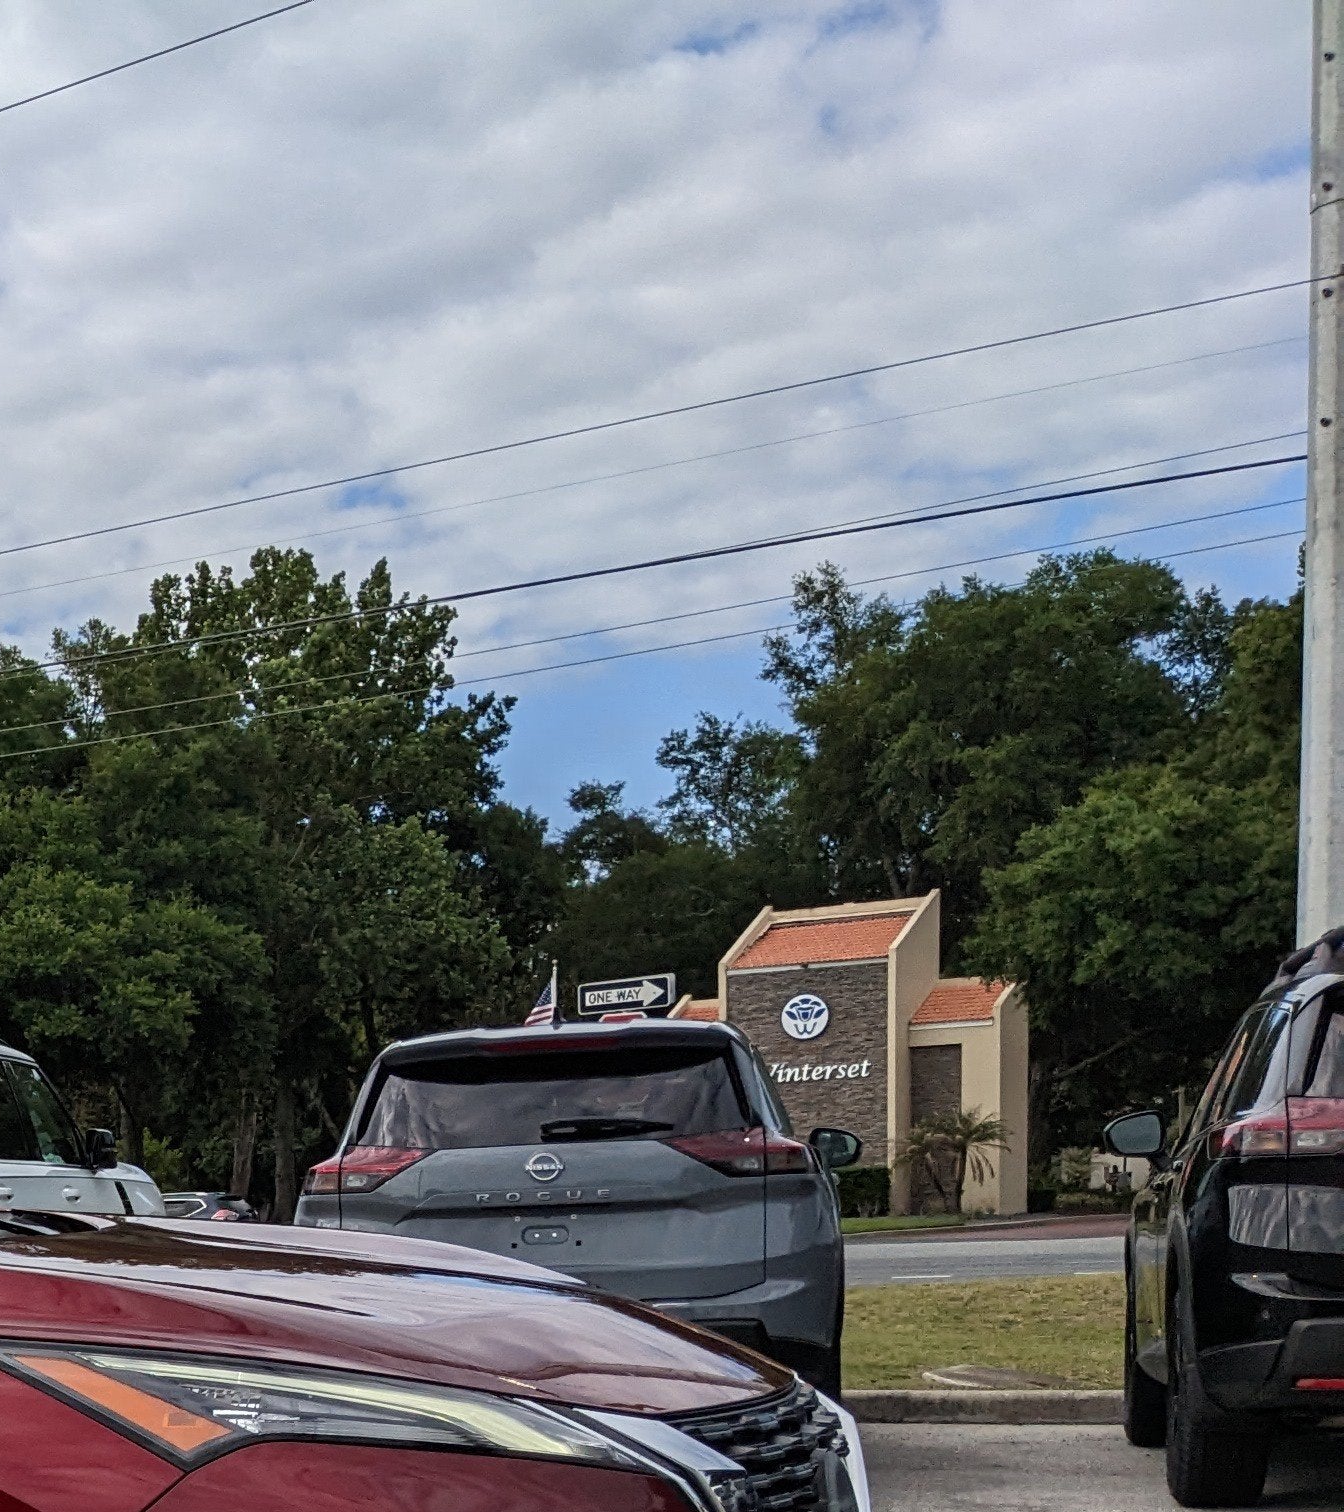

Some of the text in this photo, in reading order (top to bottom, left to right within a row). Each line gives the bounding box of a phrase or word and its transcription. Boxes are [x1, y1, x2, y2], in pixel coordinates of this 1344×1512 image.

[588, 987, 642, 1005] ONE WAY
[475, 1188, 611, 1203] ROGUE
